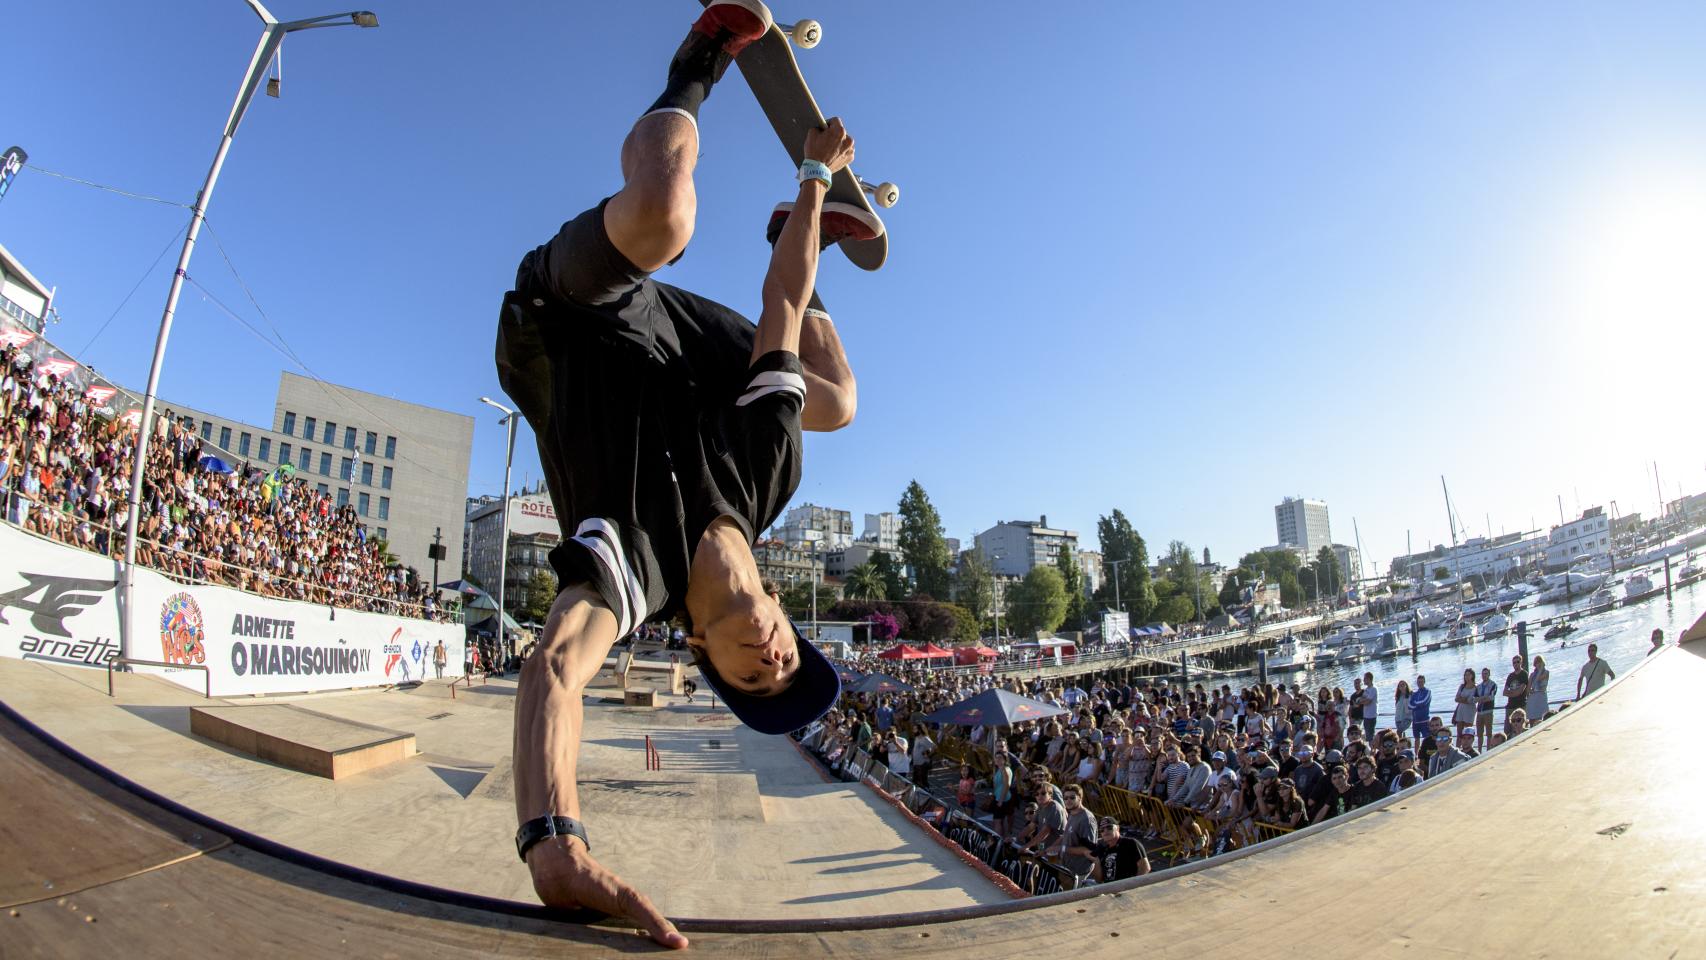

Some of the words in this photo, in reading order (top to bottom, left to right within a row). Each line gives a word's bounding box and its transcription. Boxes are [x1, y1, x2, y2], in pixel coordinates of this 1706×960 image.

[521, 502, 554, 514] HOTE
[231, 613, 295, 640] ARNETTE
[19, 636, 122, 665] arnette
[231, 641, 248, 677] O
